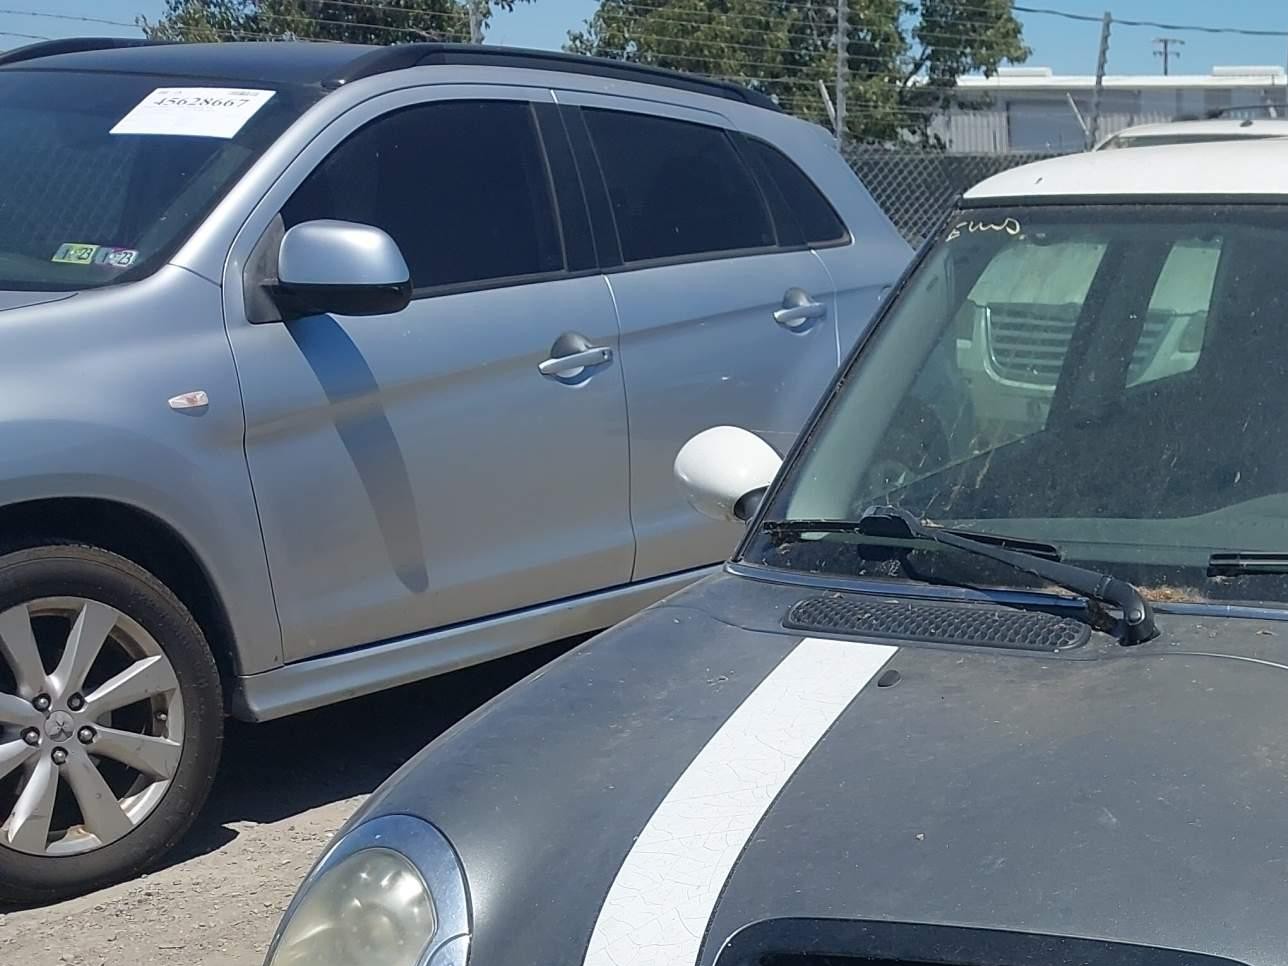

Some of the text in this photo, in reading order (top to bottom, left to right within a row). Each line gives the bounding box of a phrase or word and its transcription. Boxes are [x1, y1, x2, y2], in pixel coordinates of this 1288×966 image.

[153, 97, 249, 108] 45628667
[78, 247, 94, 260] 23
[117, 251, 133, 265] 23
